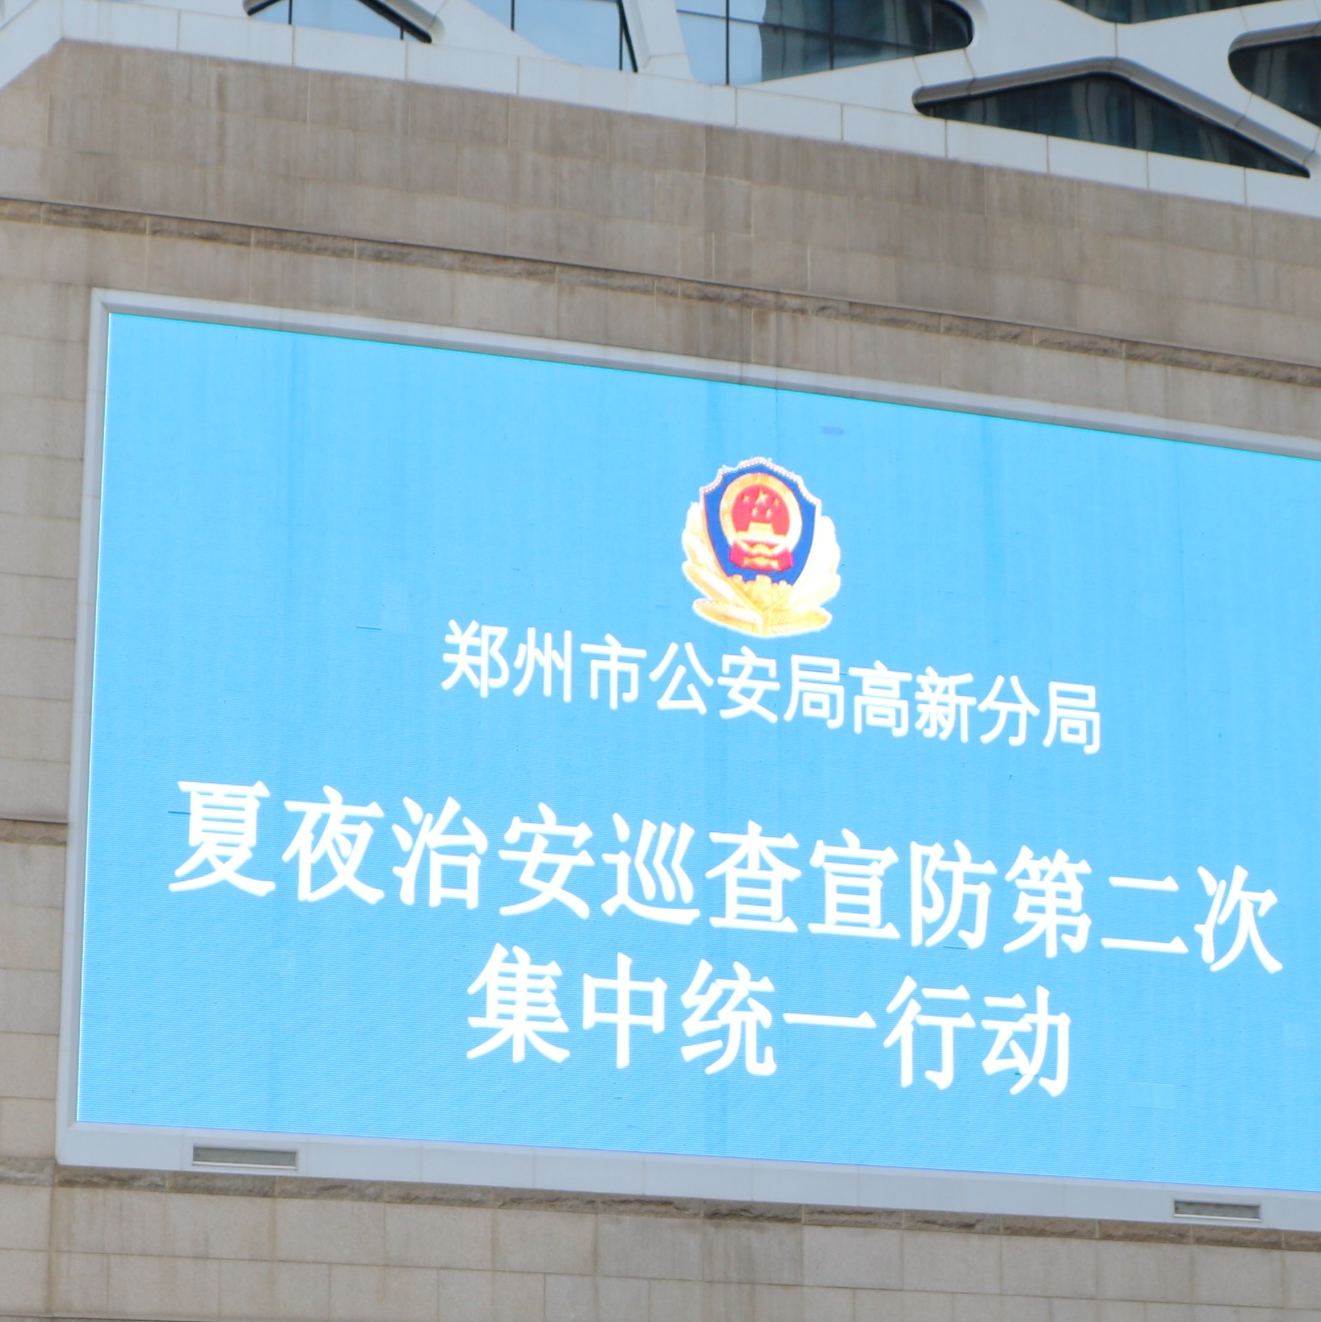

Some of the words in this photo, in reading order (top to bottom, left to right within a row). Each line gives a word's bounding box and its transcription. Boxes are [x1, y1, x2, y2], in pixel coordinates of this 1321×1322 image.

[440, 617, 1104, 756] 郑州市公安局高新分局
[167, 777, 1284, 976] 夏夜治安巡查宣防第二次
[464, 942, 1073, 1099] 集中统一行动
